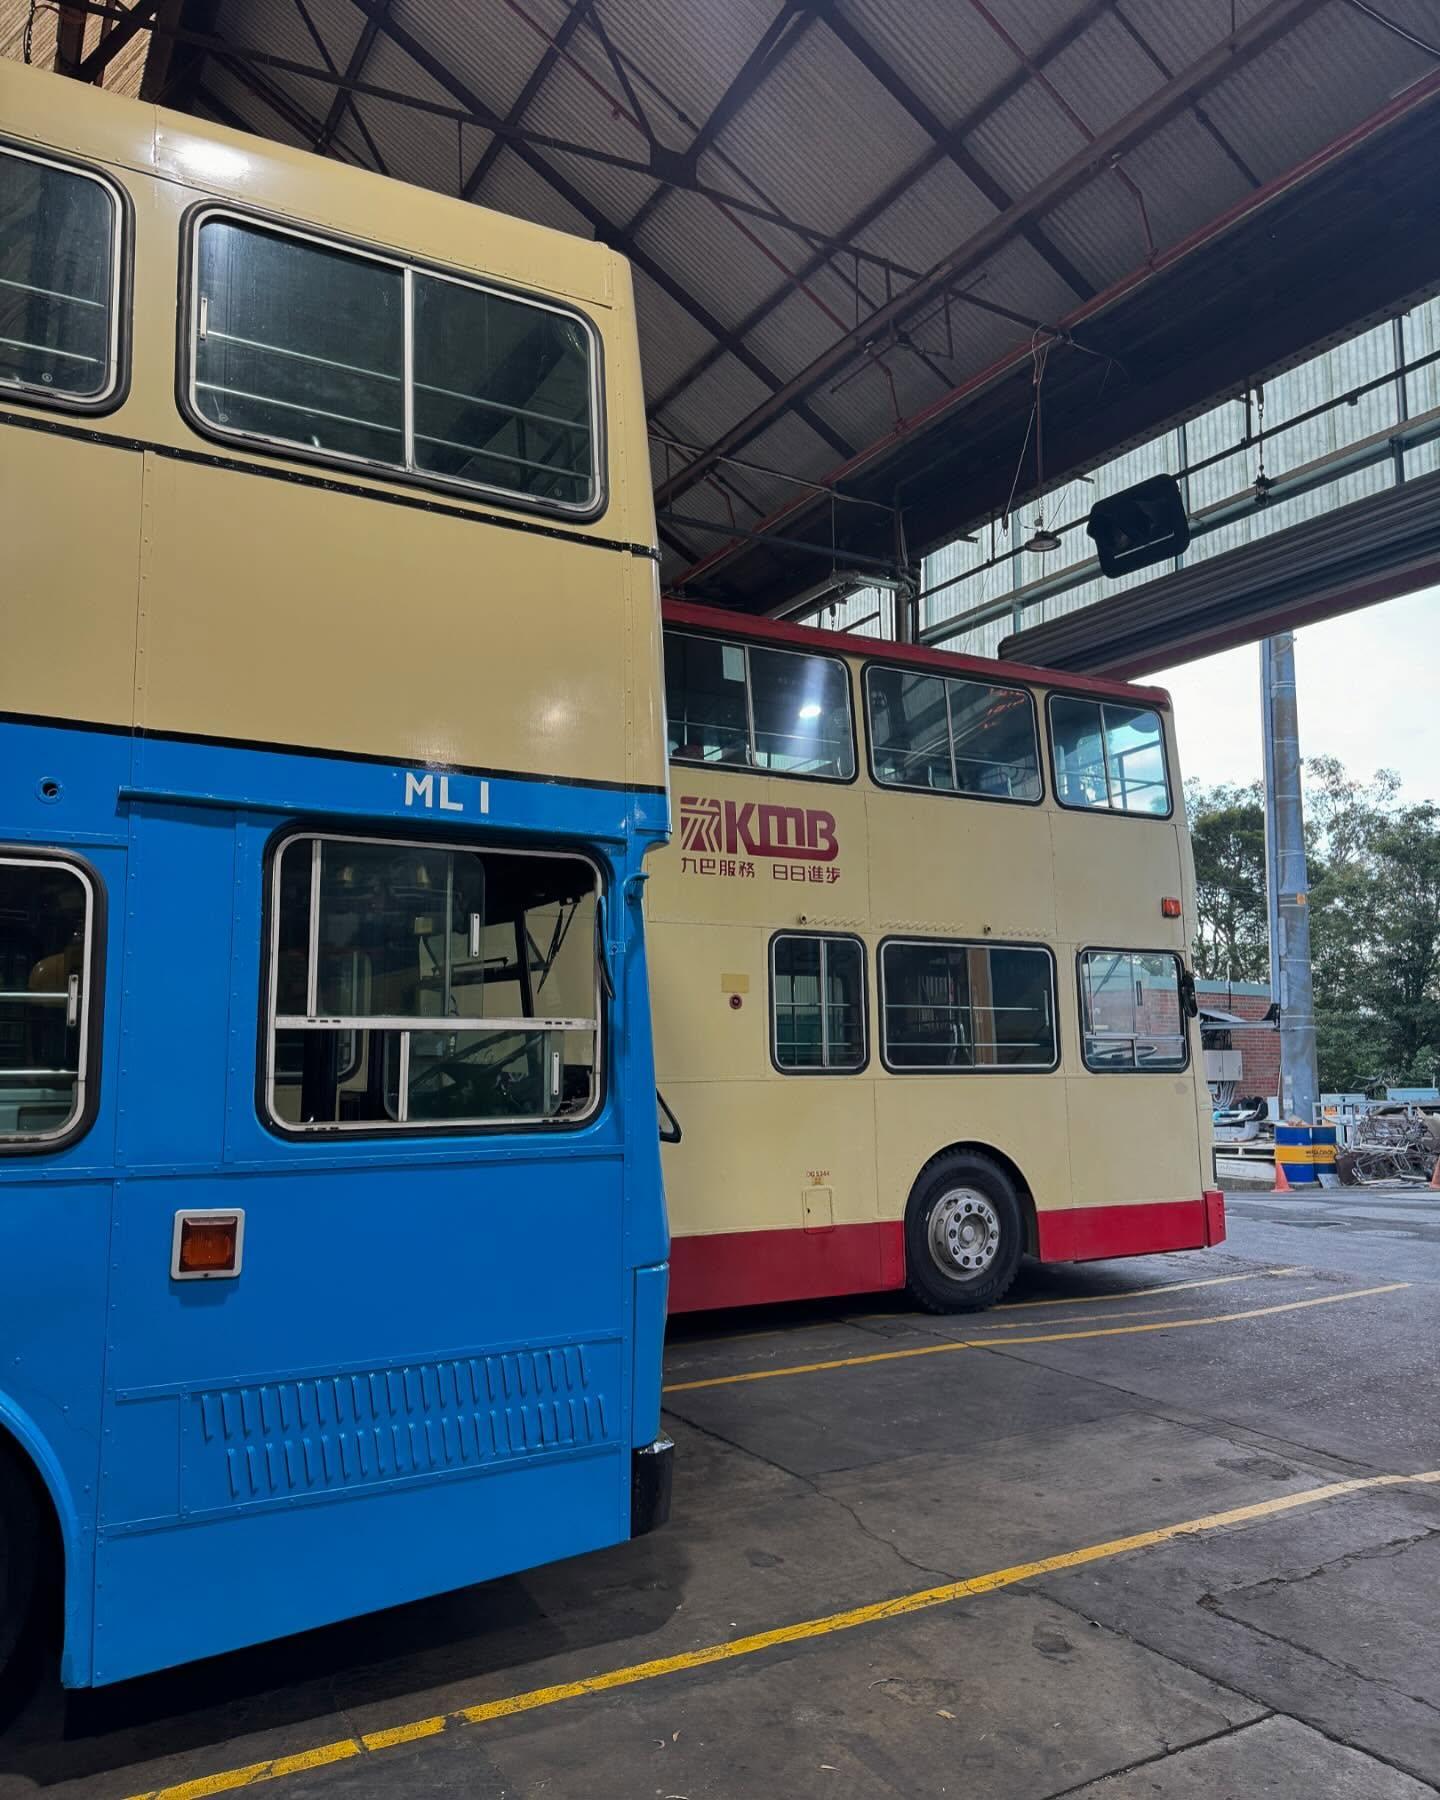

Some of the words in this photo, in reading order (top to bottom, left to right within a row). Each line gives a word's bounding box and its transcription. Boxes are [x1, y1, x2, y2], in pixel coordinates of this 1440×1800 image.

[405, 772, 463, 811] ML
[724, 800, 839, 862] KMB
[681, 857, 755, 878] 九巴服務
[772, 864, 840, 884] 日日進步
